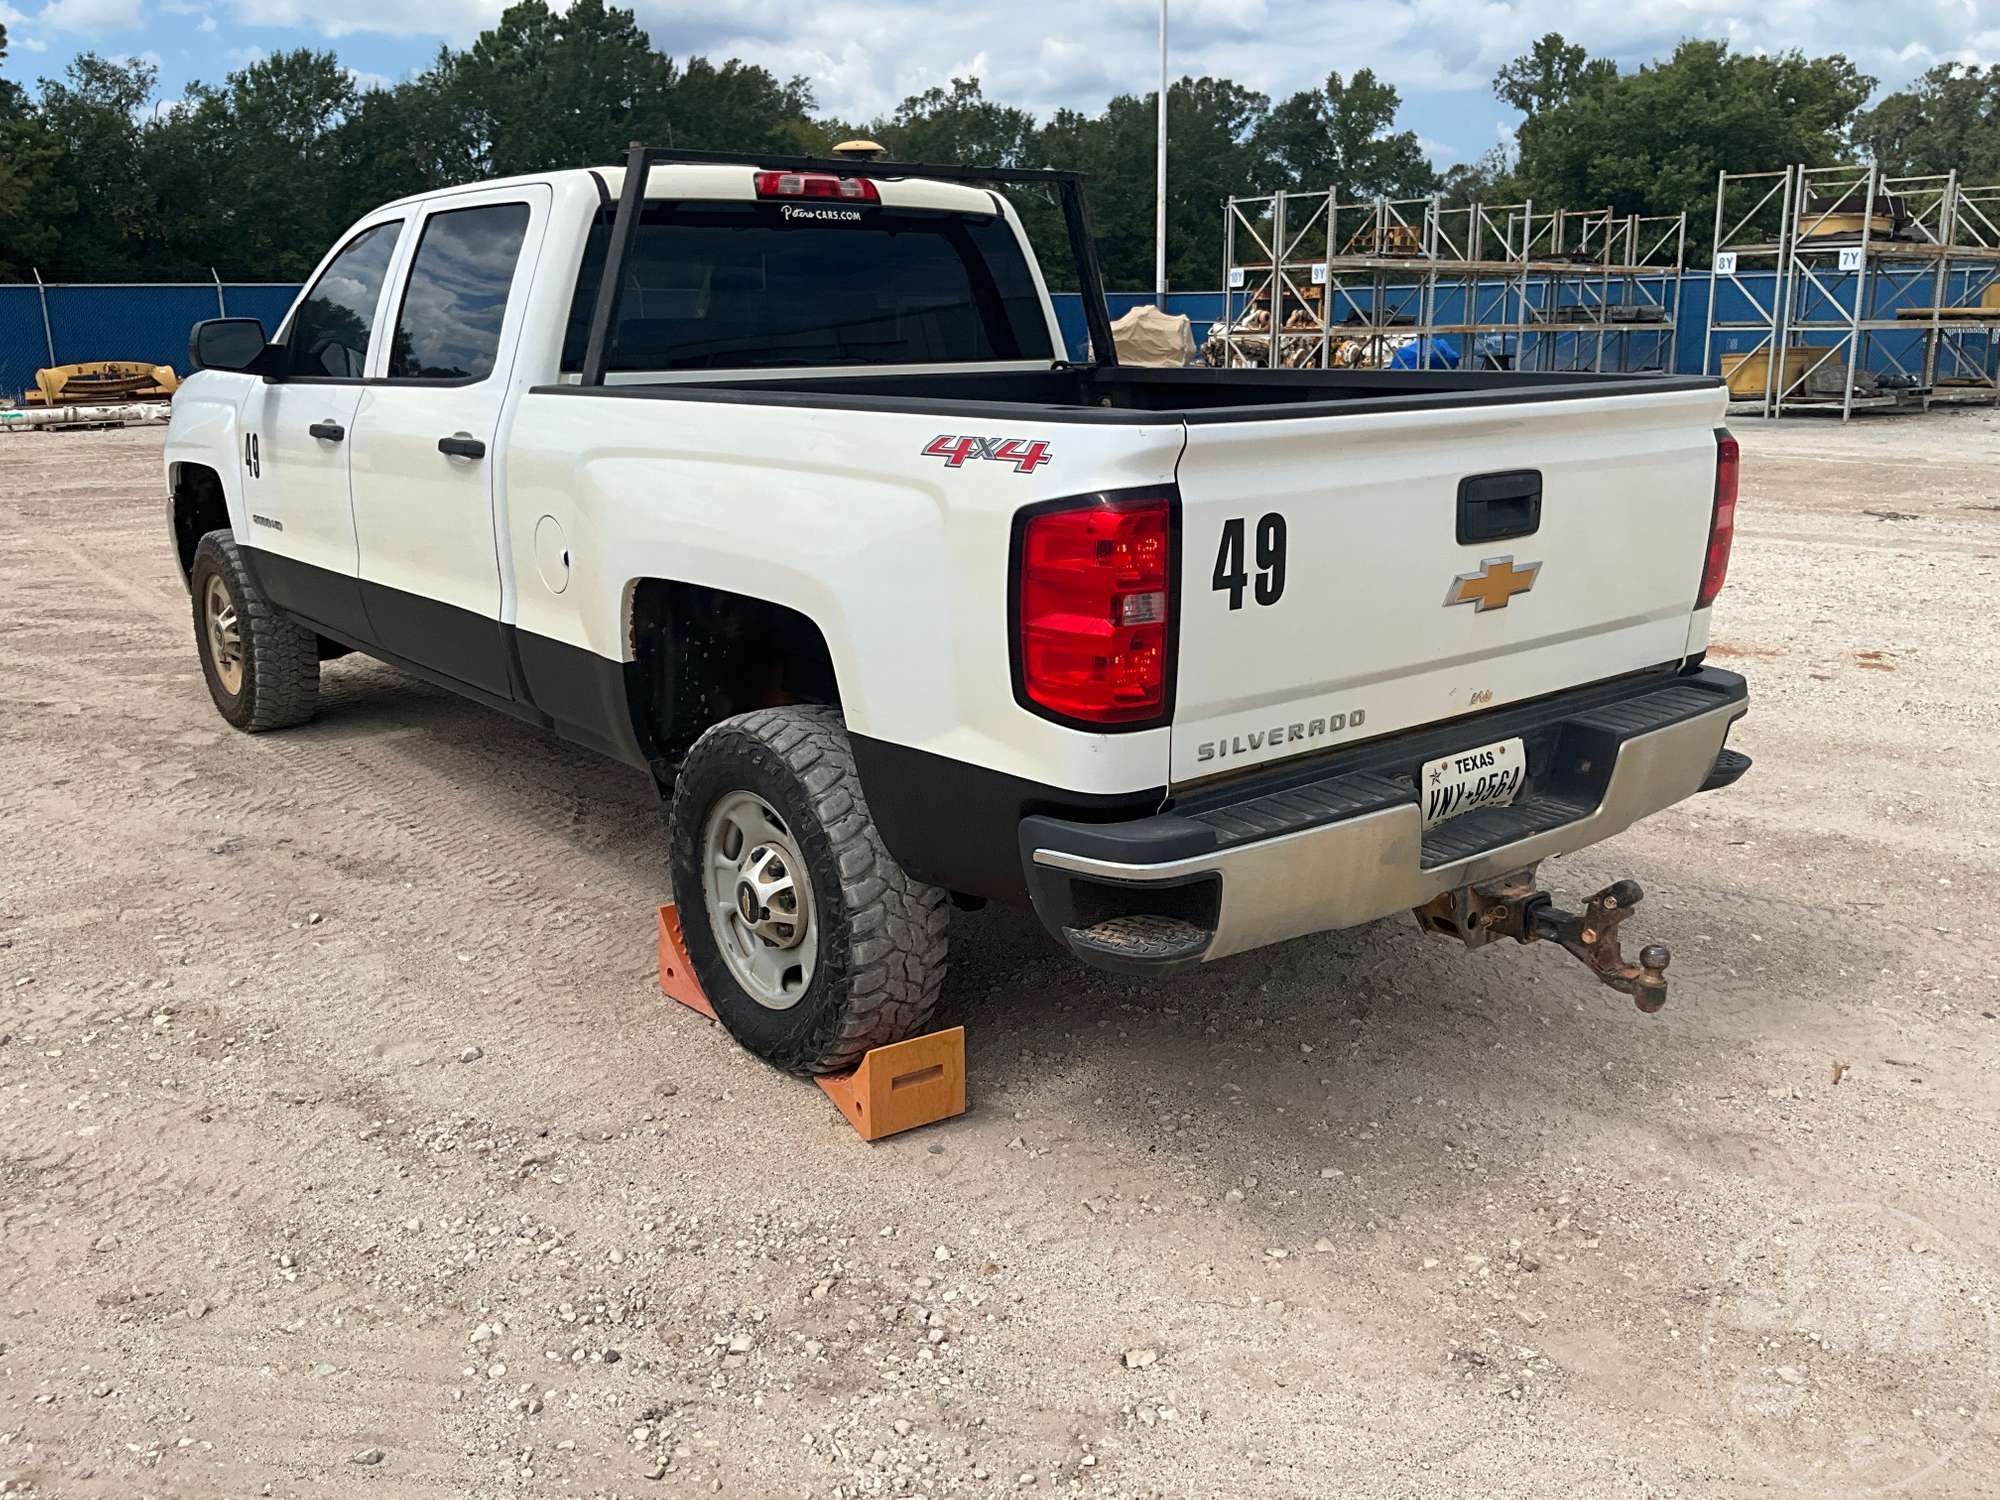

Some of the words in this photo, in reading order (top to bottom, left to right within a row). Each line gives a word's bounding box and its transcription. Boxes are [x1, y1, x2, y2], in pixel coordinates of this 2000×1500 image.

[1718, 257, 1734, 271] 8Y
[1843, 252, 1860, 266] 7Y
[1313, 268, 1326, 280] 9Y
[245, 432, 260, 479] 49
[1212, 512, 1287, 611] 49
[1197, 709, 1366, 762] SILVERADO
[1455, 751, 1495, 774] TEXAS
